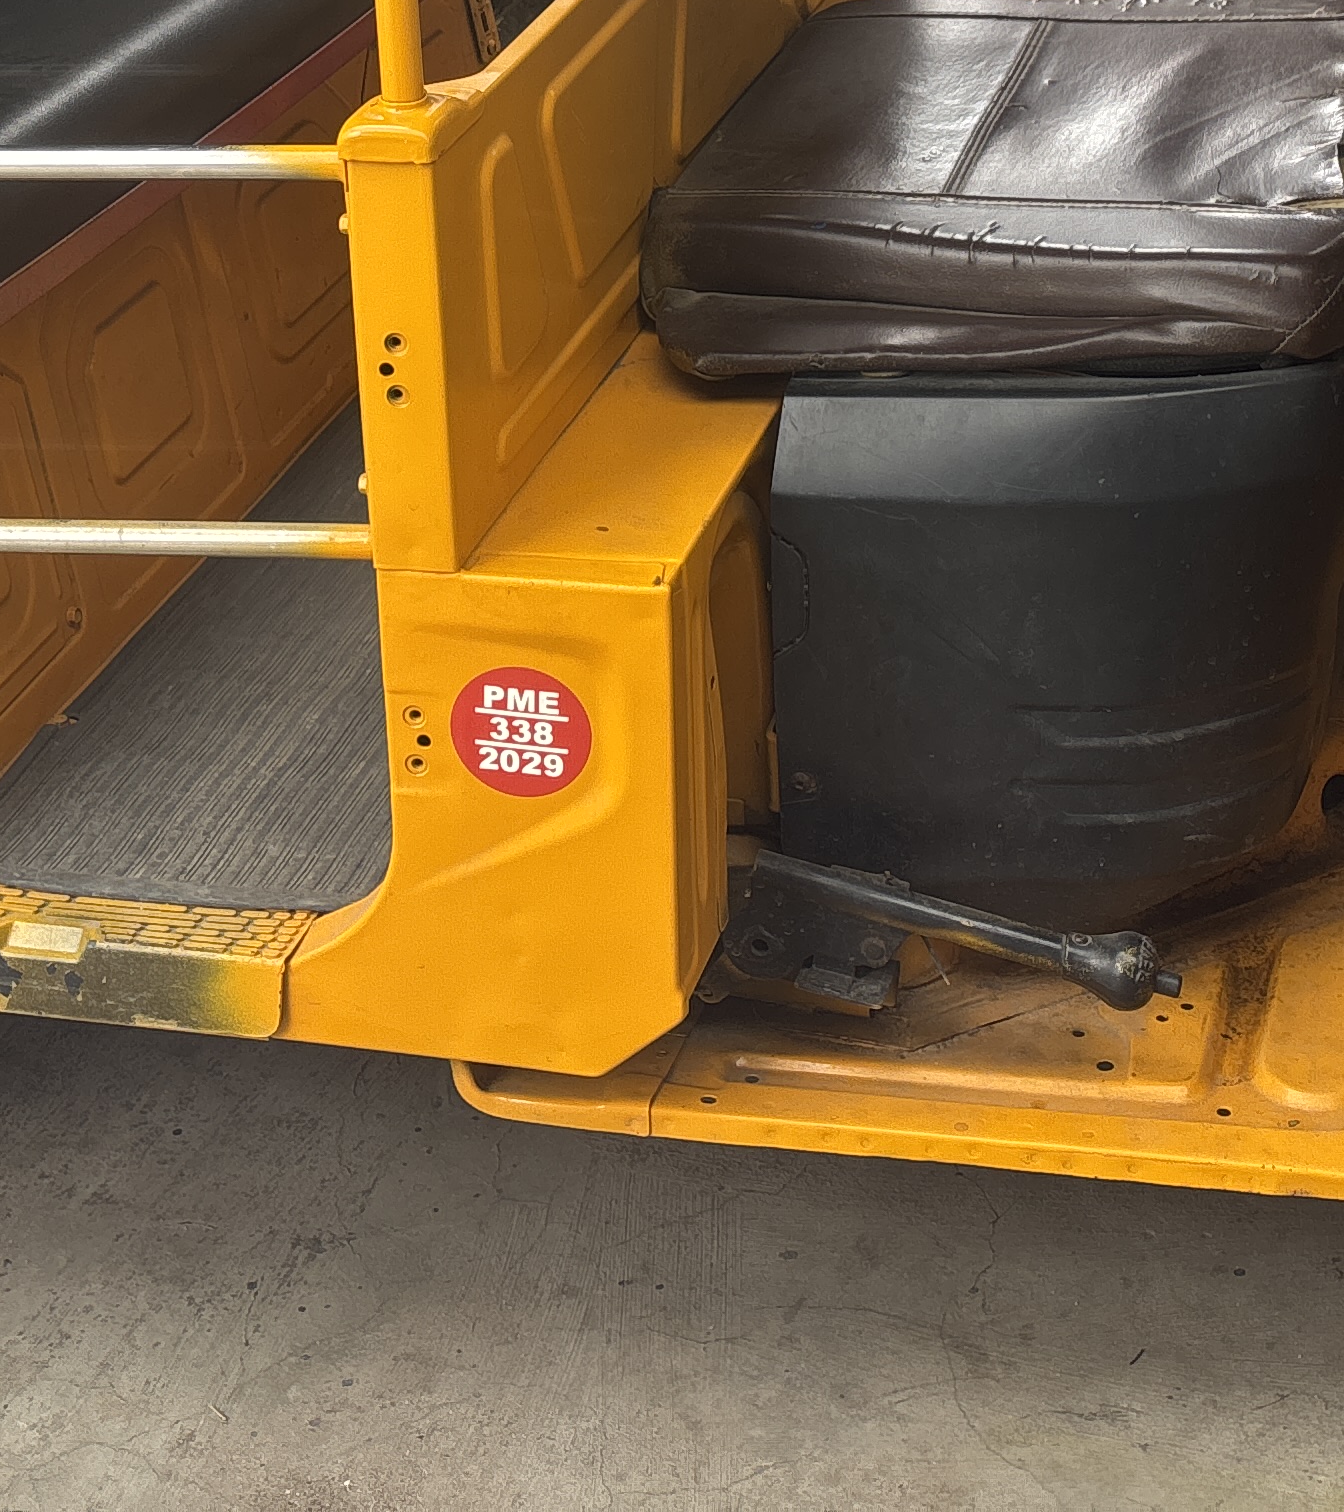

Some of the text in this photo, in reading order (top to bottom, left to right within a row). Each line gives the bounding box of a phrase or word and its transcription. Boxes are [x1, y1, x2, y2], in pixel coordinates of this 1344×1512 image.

[483, 685, 560, 715] PME
[489, 716, 554, 745] 338
[478, 746, 564, 777] 2029
